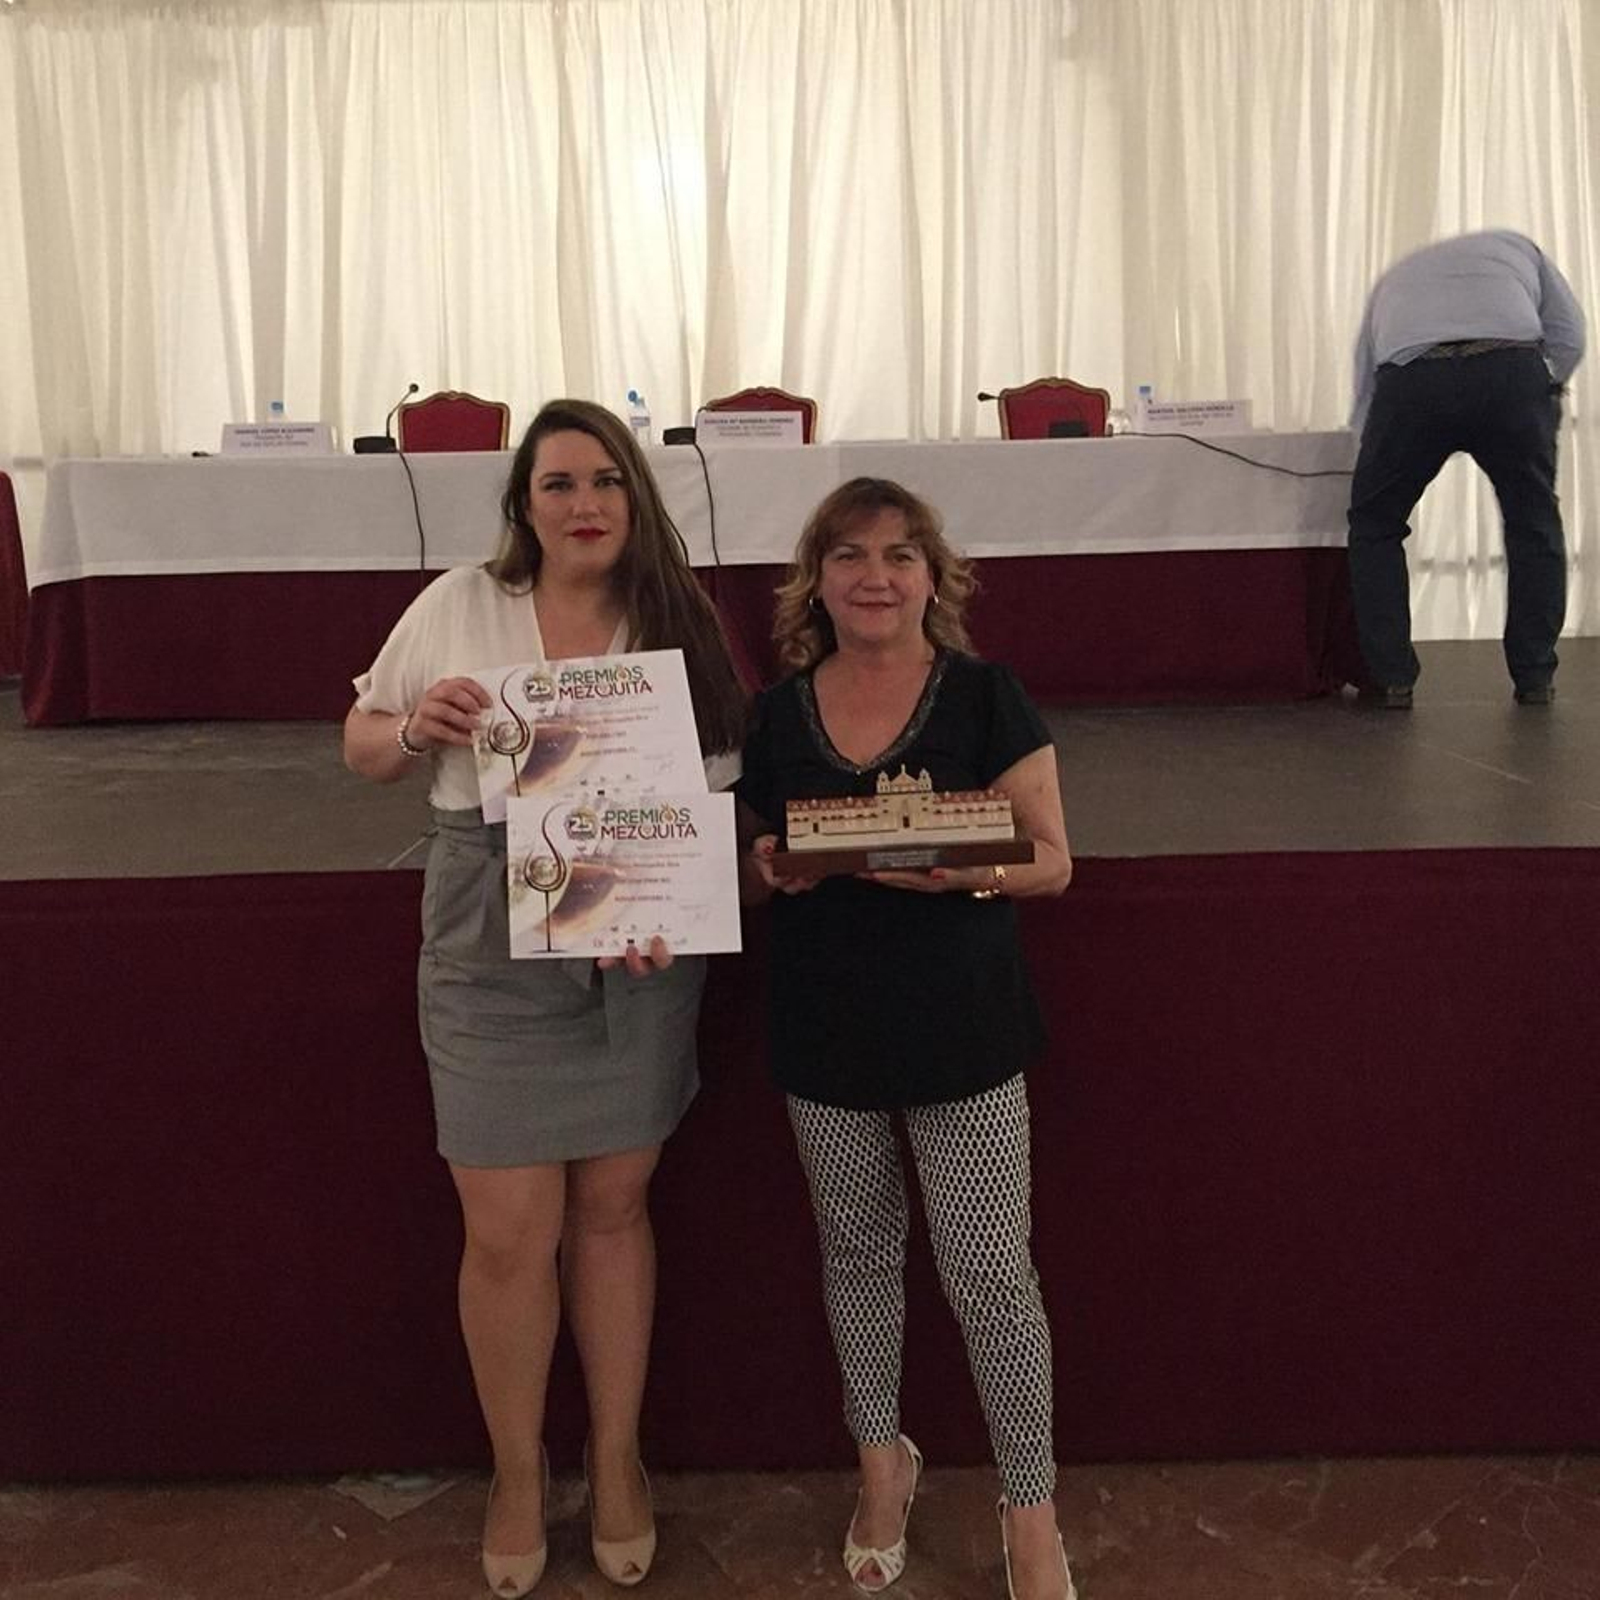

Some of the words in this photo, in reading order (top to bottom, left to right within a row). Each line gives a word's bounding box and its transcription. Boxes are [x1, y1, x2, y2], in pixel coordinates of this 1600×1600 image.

[558, 665, 644, 686] PREMIOS
[558, 679, 654, 701] MEZQUITA
[601, 806, 692, 825] PREMIOS
[600, 823, 699, 841] MEZQUITA
